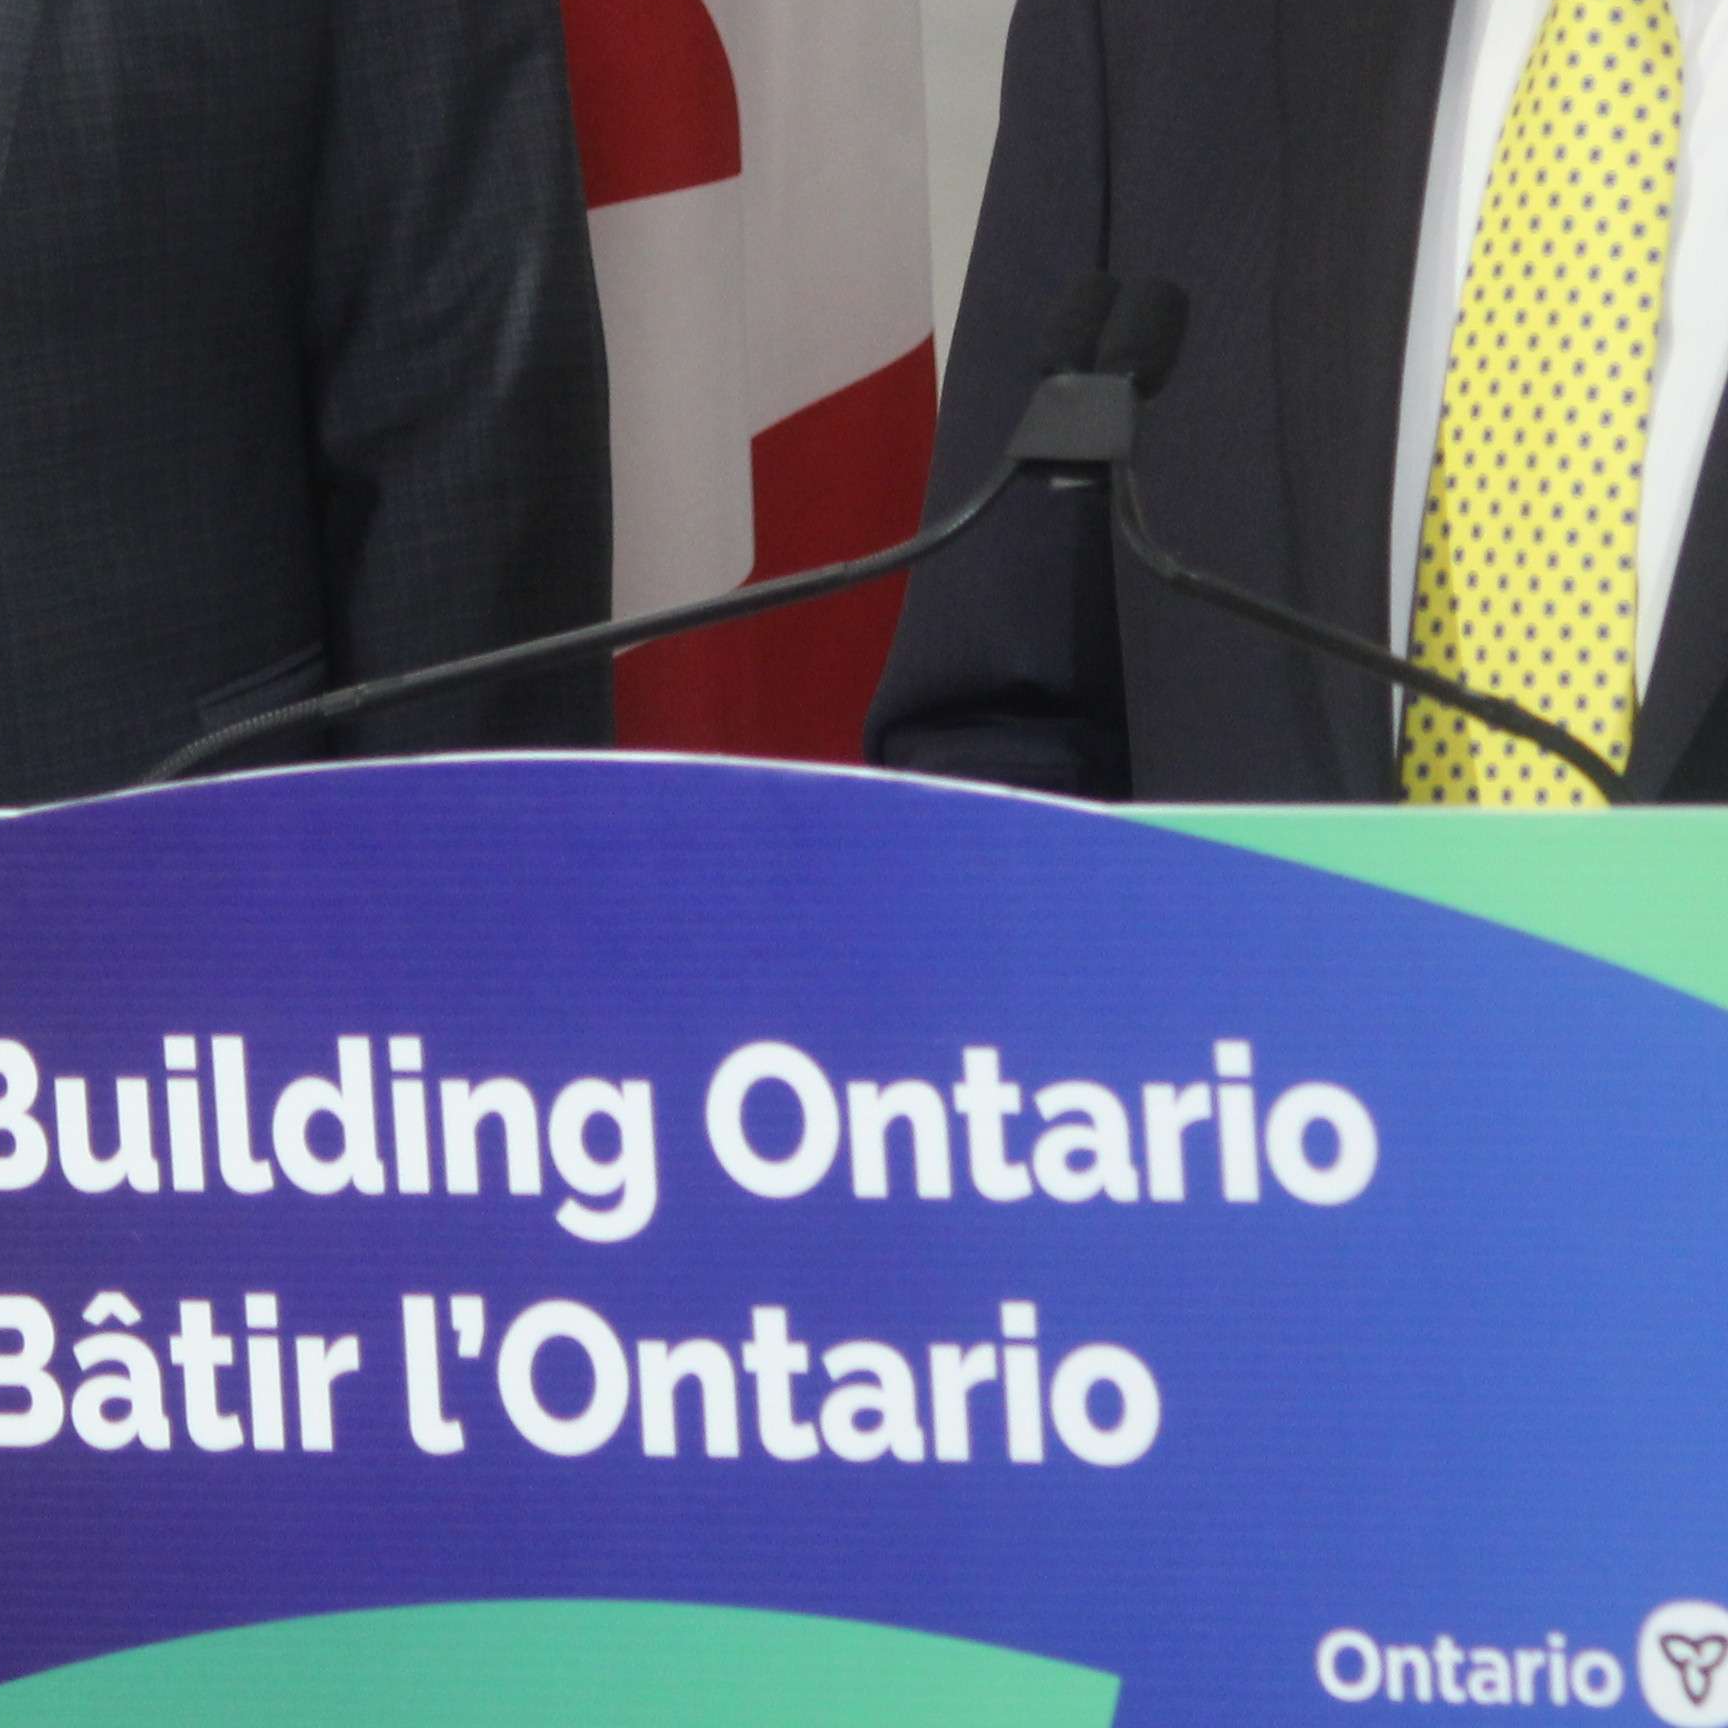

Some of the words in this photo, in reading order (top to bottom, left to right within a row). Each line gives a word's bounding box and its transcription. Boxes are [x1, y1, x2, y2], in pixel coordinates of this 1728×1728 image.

[703, 1036, 1381, 1208] Ontario
[400, 1292, 1164, 1469] l’Ontario
[1315, 1627, 1626, 1710] Ontario
